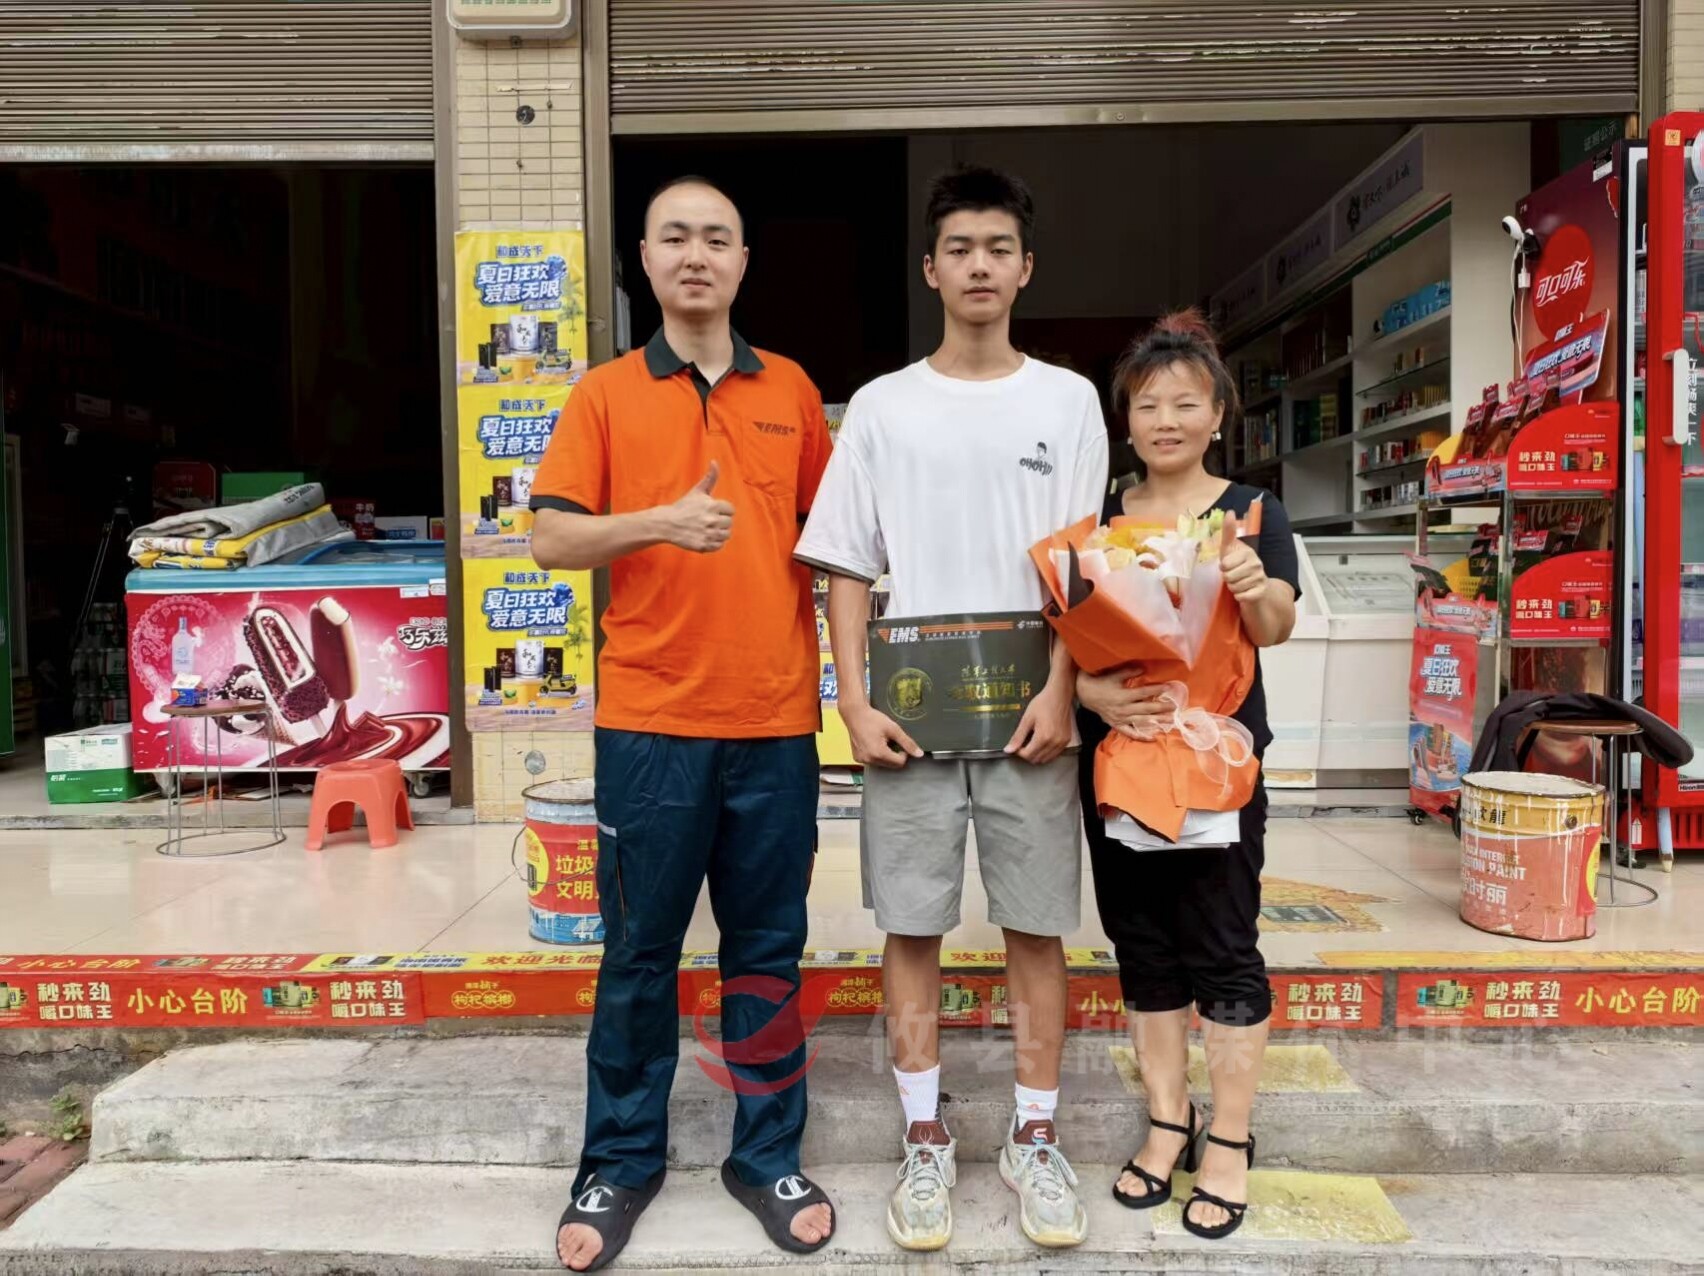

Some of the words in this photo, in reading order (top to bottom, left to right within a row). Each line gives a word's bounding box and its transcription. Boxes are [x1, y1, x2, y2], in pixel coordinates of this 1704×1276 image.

[478, 264, 549, 284] 夏日狂欢
[484, 280, 560, 303] 爱意无限
[481, 417, 551, 438] 夏日狂欢
[487, 435, 549, 456] 爱意无
[485, 590, 557, 610] 夏日狂欢
[490, 607, 566, 627] 爱意无限
[889, 627, 919, 644] EMS
[17, 959, 140, 969] 小心台阶
[37, 982, 111, 1002] 秒来劲
[330, 980, 404, 1000] 秒来劲
[1287, 982, 1363, 1003] 秒来劲
[1486, 981, 1561, 1000] 秒来劲
[1575, 986, 1702, 1014] 小心台阶
[128, 988, 247, 1014] 小心台阶
